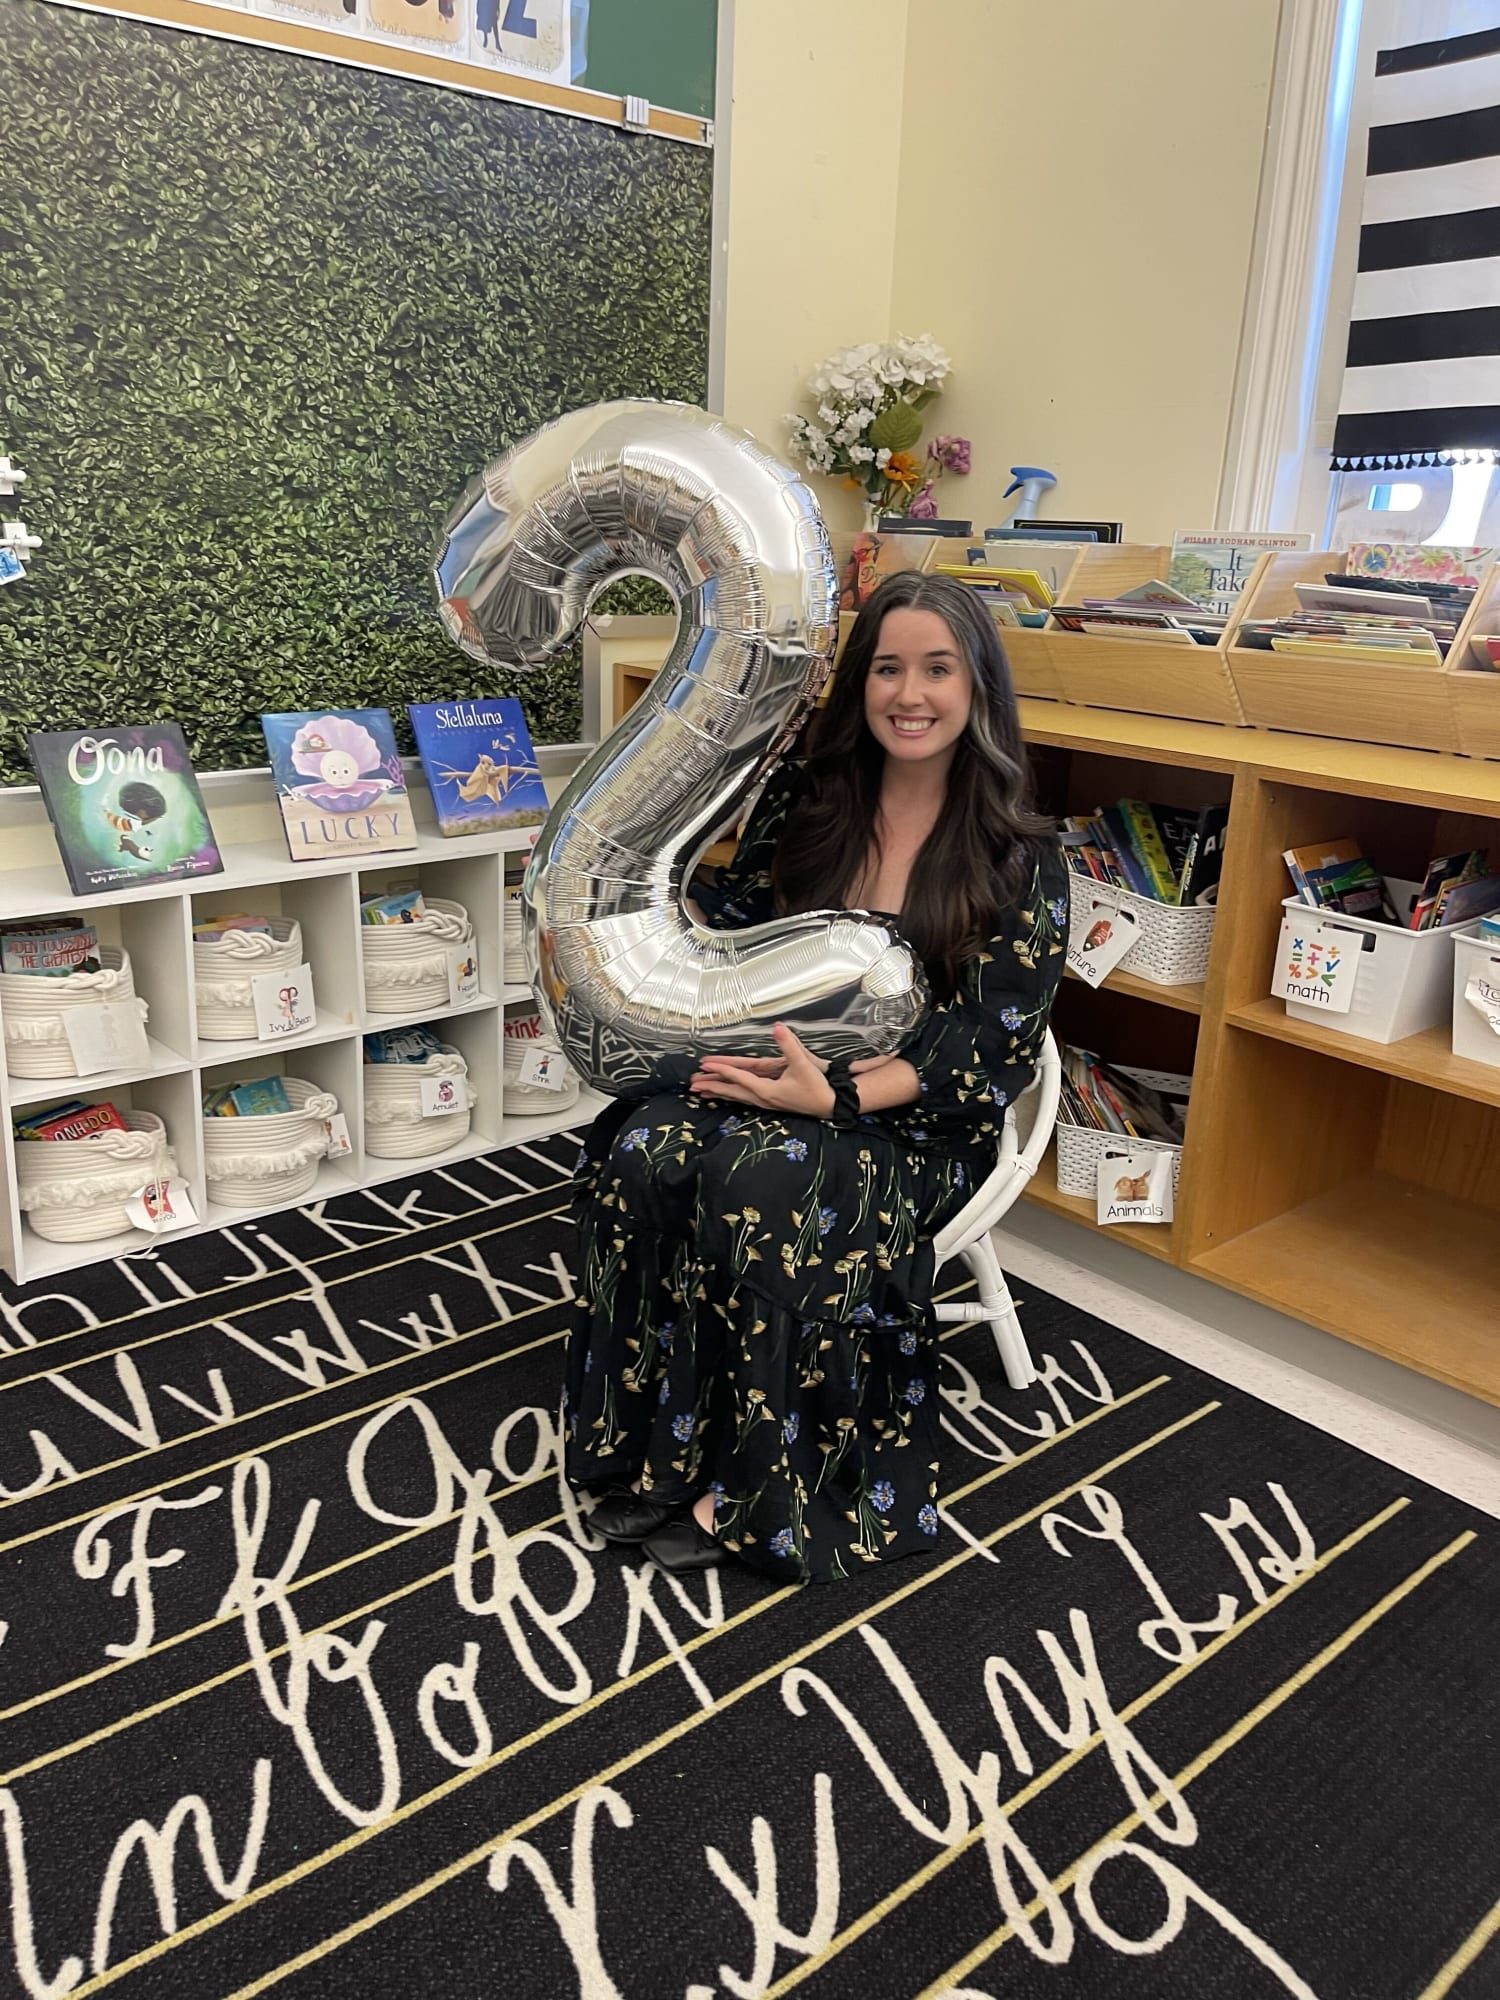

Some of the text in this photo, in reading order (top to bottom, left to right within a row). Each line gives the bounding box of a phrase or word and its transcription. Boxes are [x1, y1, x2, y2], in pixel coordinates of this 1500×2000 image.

[1183, 536, 1218, 545] HILLARY
[1258, 539, 1297, 548] CLINTON
[1225, 547, 1244, 571] It
[435, 704, 503, 729] Stellaluna
[67, 736, 164, 786] Oona
[299, 812, 402, 845] LUCKY
[1286, 982, 1330, 1003] math
[432, 1102, 459, 1111] Amulet
[1106, 1204, 1164, 1219] Animals
